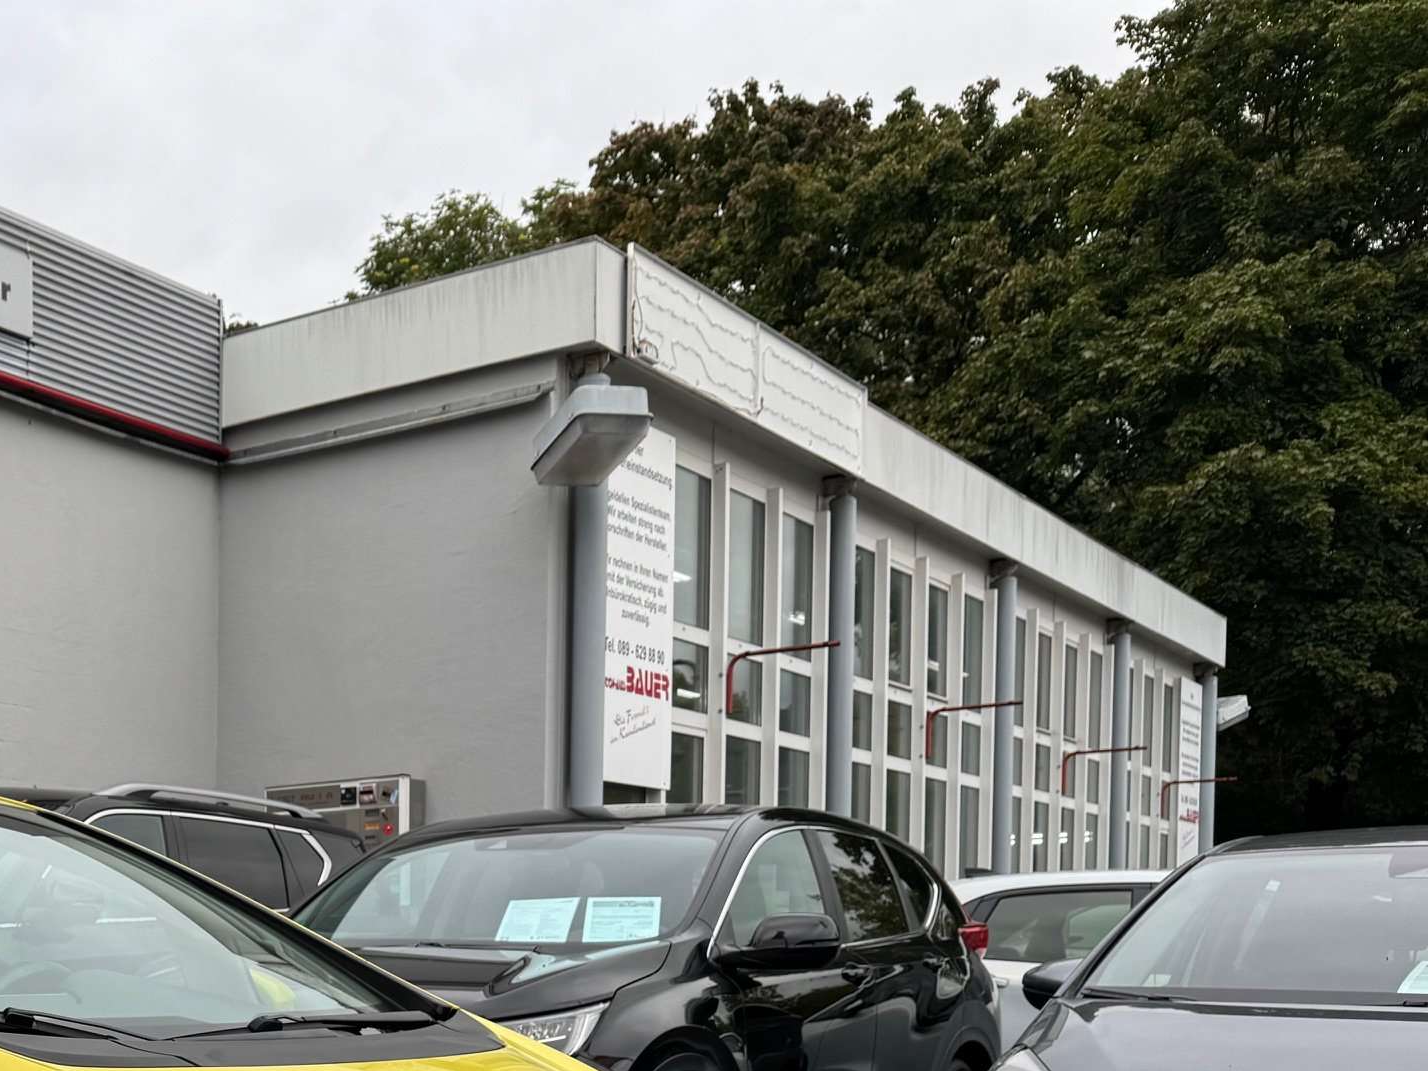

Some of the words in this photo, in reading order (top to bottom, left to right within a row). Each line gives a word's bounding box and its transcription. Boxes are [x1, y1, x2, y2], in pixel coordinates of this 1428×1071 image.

[607, 523, 634, 539] orschriften
[618, 639, 630, 656] 089
[636, 644, 647, 661] 629
[657, 649, 665, 665] 90
[627, 665, 669, 701] BAUER
